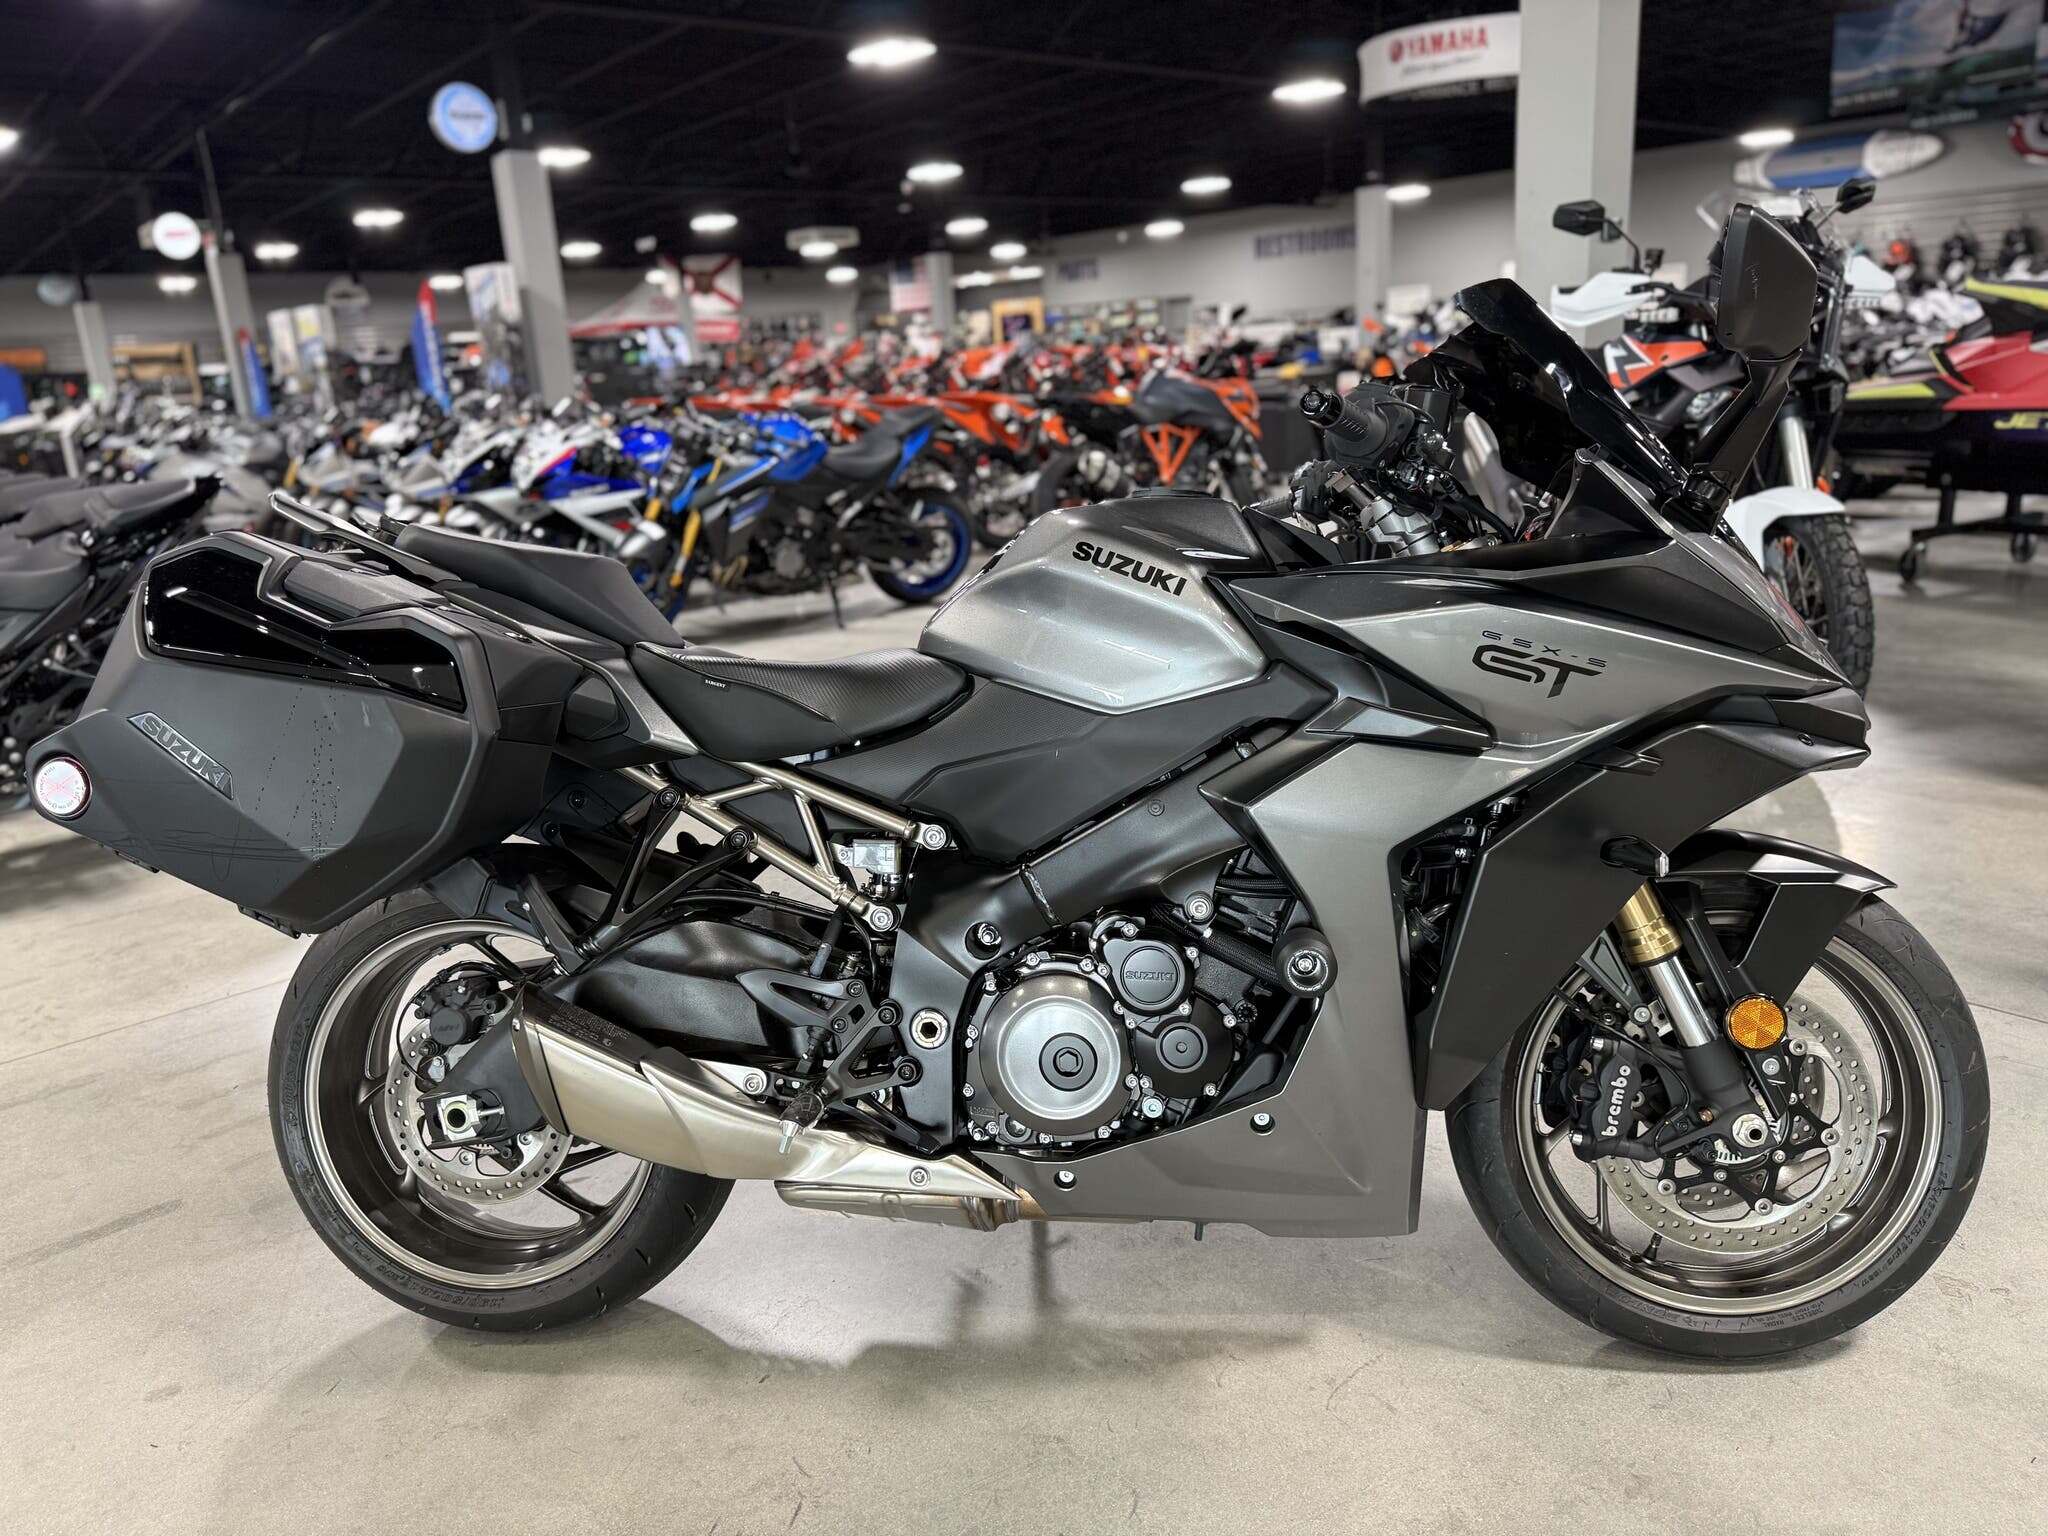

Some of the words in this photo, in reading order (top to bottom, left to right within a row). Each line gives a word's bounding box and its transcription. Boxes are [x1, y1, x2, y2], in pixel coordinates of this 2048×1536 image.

[1407, 26, 1488, 56] YAMAHA
[1072, 541, 1187, 596] SUZUKI
[1472, 644, 1602, 698] GT
[142, 715, 230, 791] SUZUKI
[1125, 970, 1174, 981] SUZUKI
[1601, 1065, 1631, 1137] brembo
